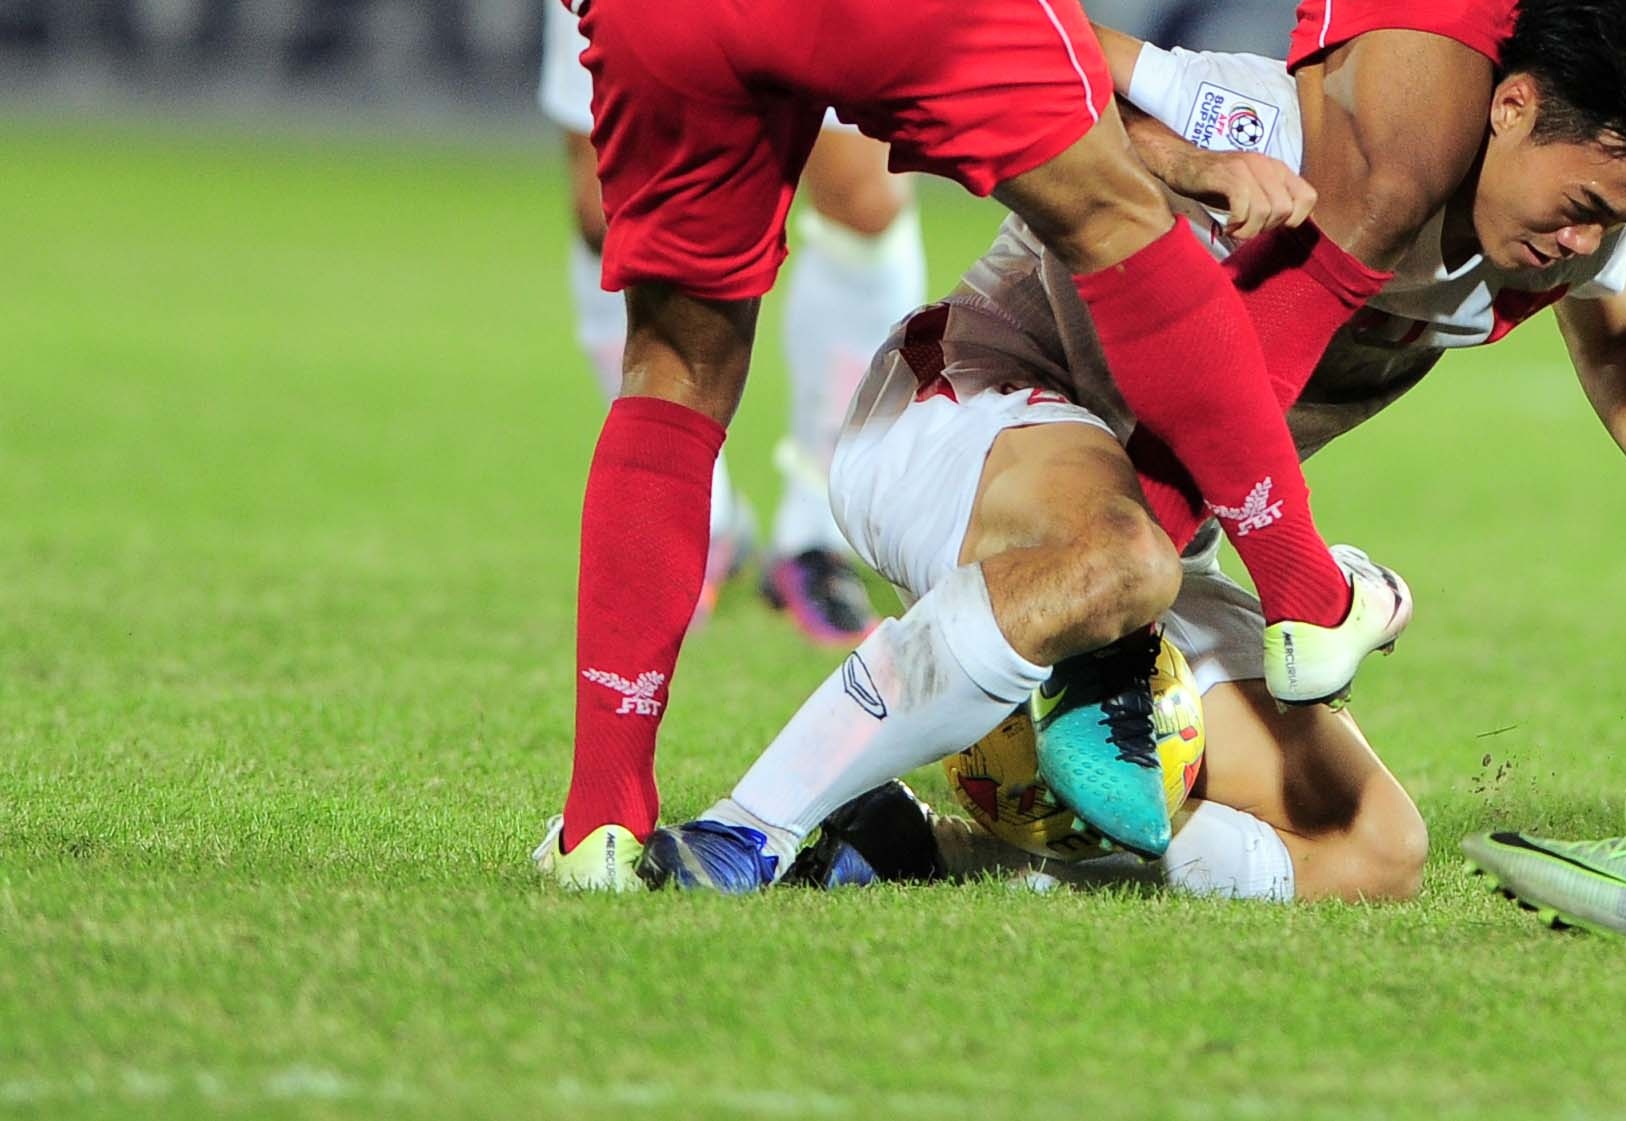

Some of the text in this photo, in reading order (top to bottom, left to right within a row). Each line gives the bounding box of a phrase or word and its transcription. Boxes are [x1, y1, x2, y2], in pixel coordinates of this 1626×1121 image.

[1200, 91, 1215, 120] CUP
[1237, 499, 1284, 536] FBT
[616, 696, 662, 717] FBT
